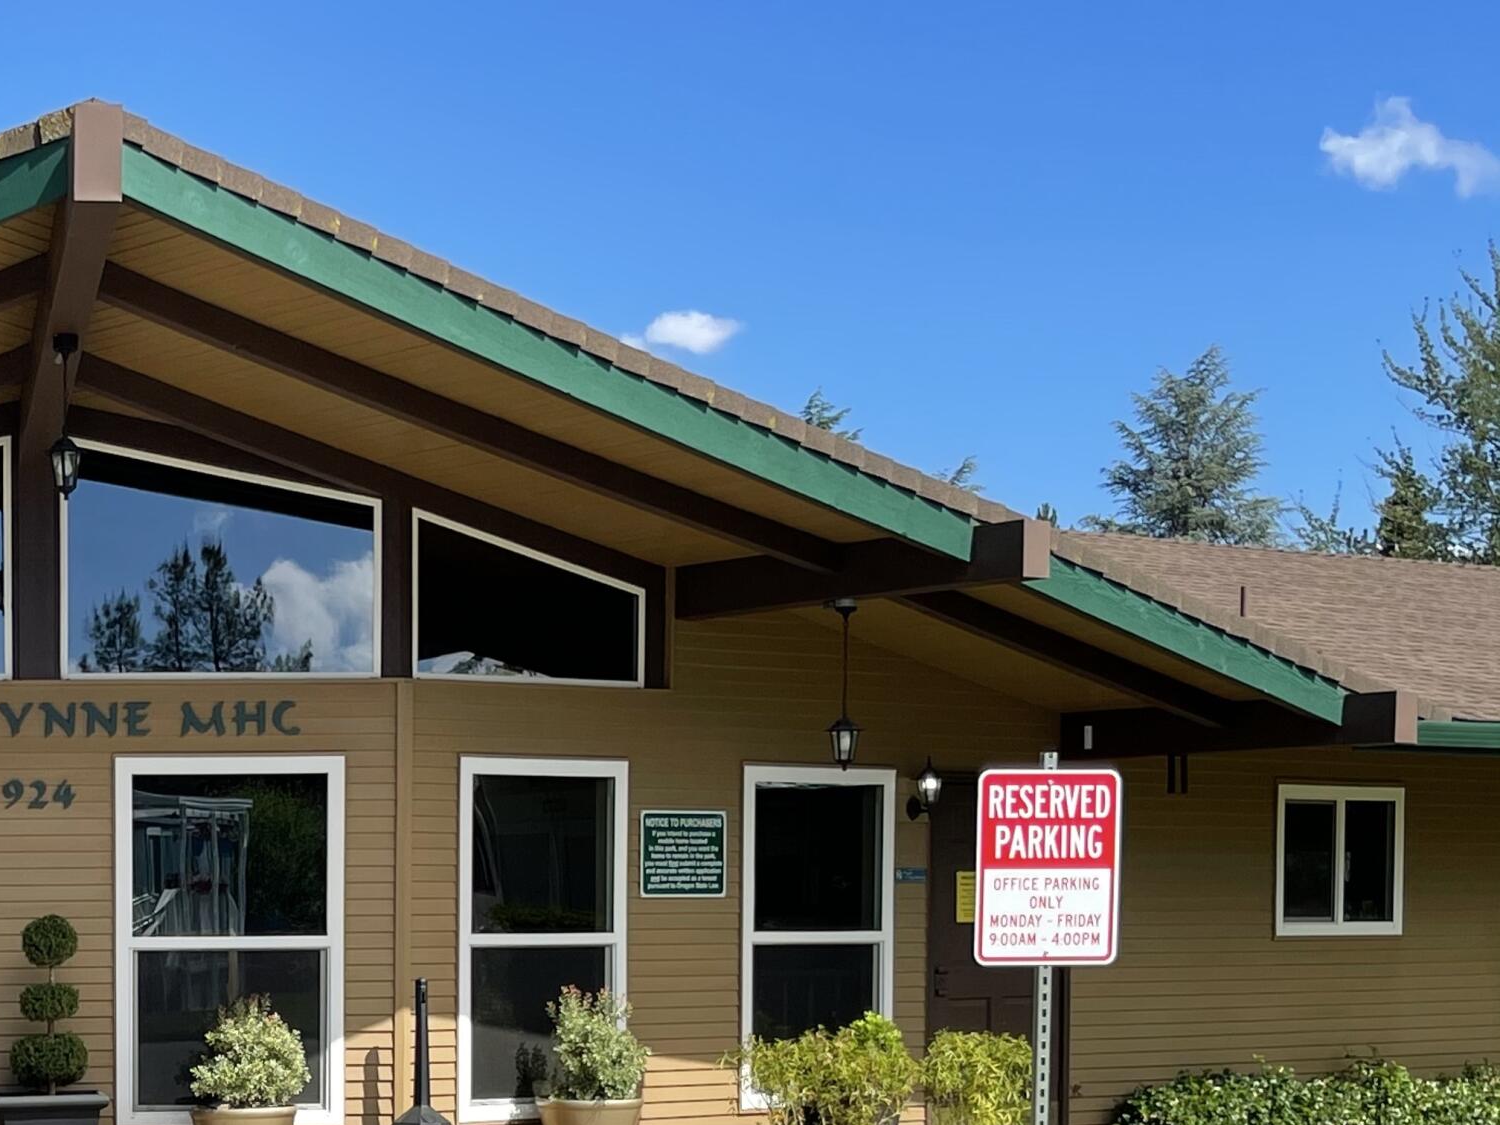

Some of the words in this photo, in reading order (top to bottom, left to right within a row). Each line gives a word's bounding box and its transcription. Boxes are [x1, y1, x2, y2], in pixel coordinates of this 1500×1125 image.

[181, 700, 301, 737] MHC
[2, 779, 77, 810] 924
[989, 785, 1111, 819] RESERVED
[670, 818, 679, 827] TO
[995, 825, 1103, 859] PARKING
[993, 878, 1039, 891] OFFICE
[1044, 877, 1100, 890] PARKING
[1029, 896, 1063, 909] ONLY
[990, 915, 1042, 927] MONDAY
[1057, 914, 1101, 927] FRIDAY
